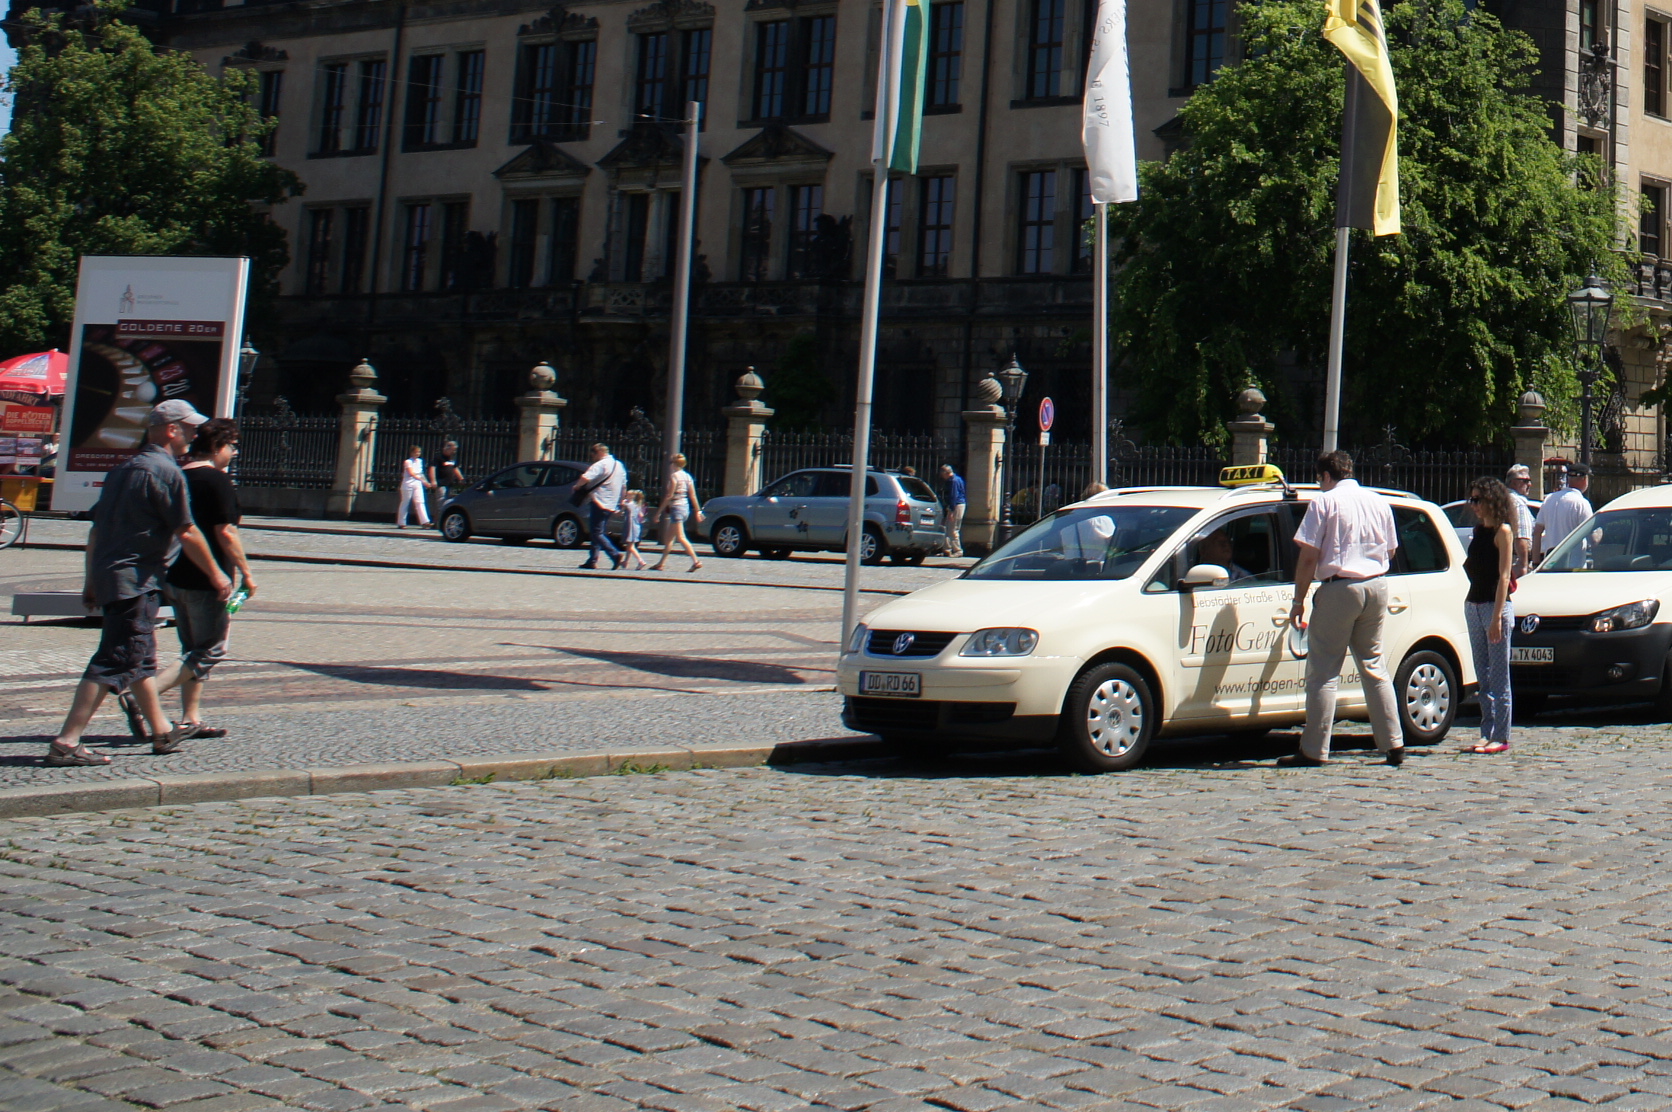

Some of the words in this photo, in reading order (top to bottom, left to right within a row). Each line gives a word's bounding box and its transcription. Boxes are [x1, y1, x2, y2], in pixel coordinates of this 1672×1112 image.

[1094, 96, 1110, 127] 1897
[120, 323, 182, 332] GOLDENE
[6, 411, 19, 419] DIE
[1226, 468, 1259, 480] TAXI
[1244, 590, 1273, 604] Straße
[1188, 621, 1278, 655] FotoGen
[1519, 648, 1530, 661] TX
[1531, 648, 1553, 661] 4043
[868, 674, 881, 689] DD
[886, 675, 900, 690] RD
[902, 675, 915, 691] 66
